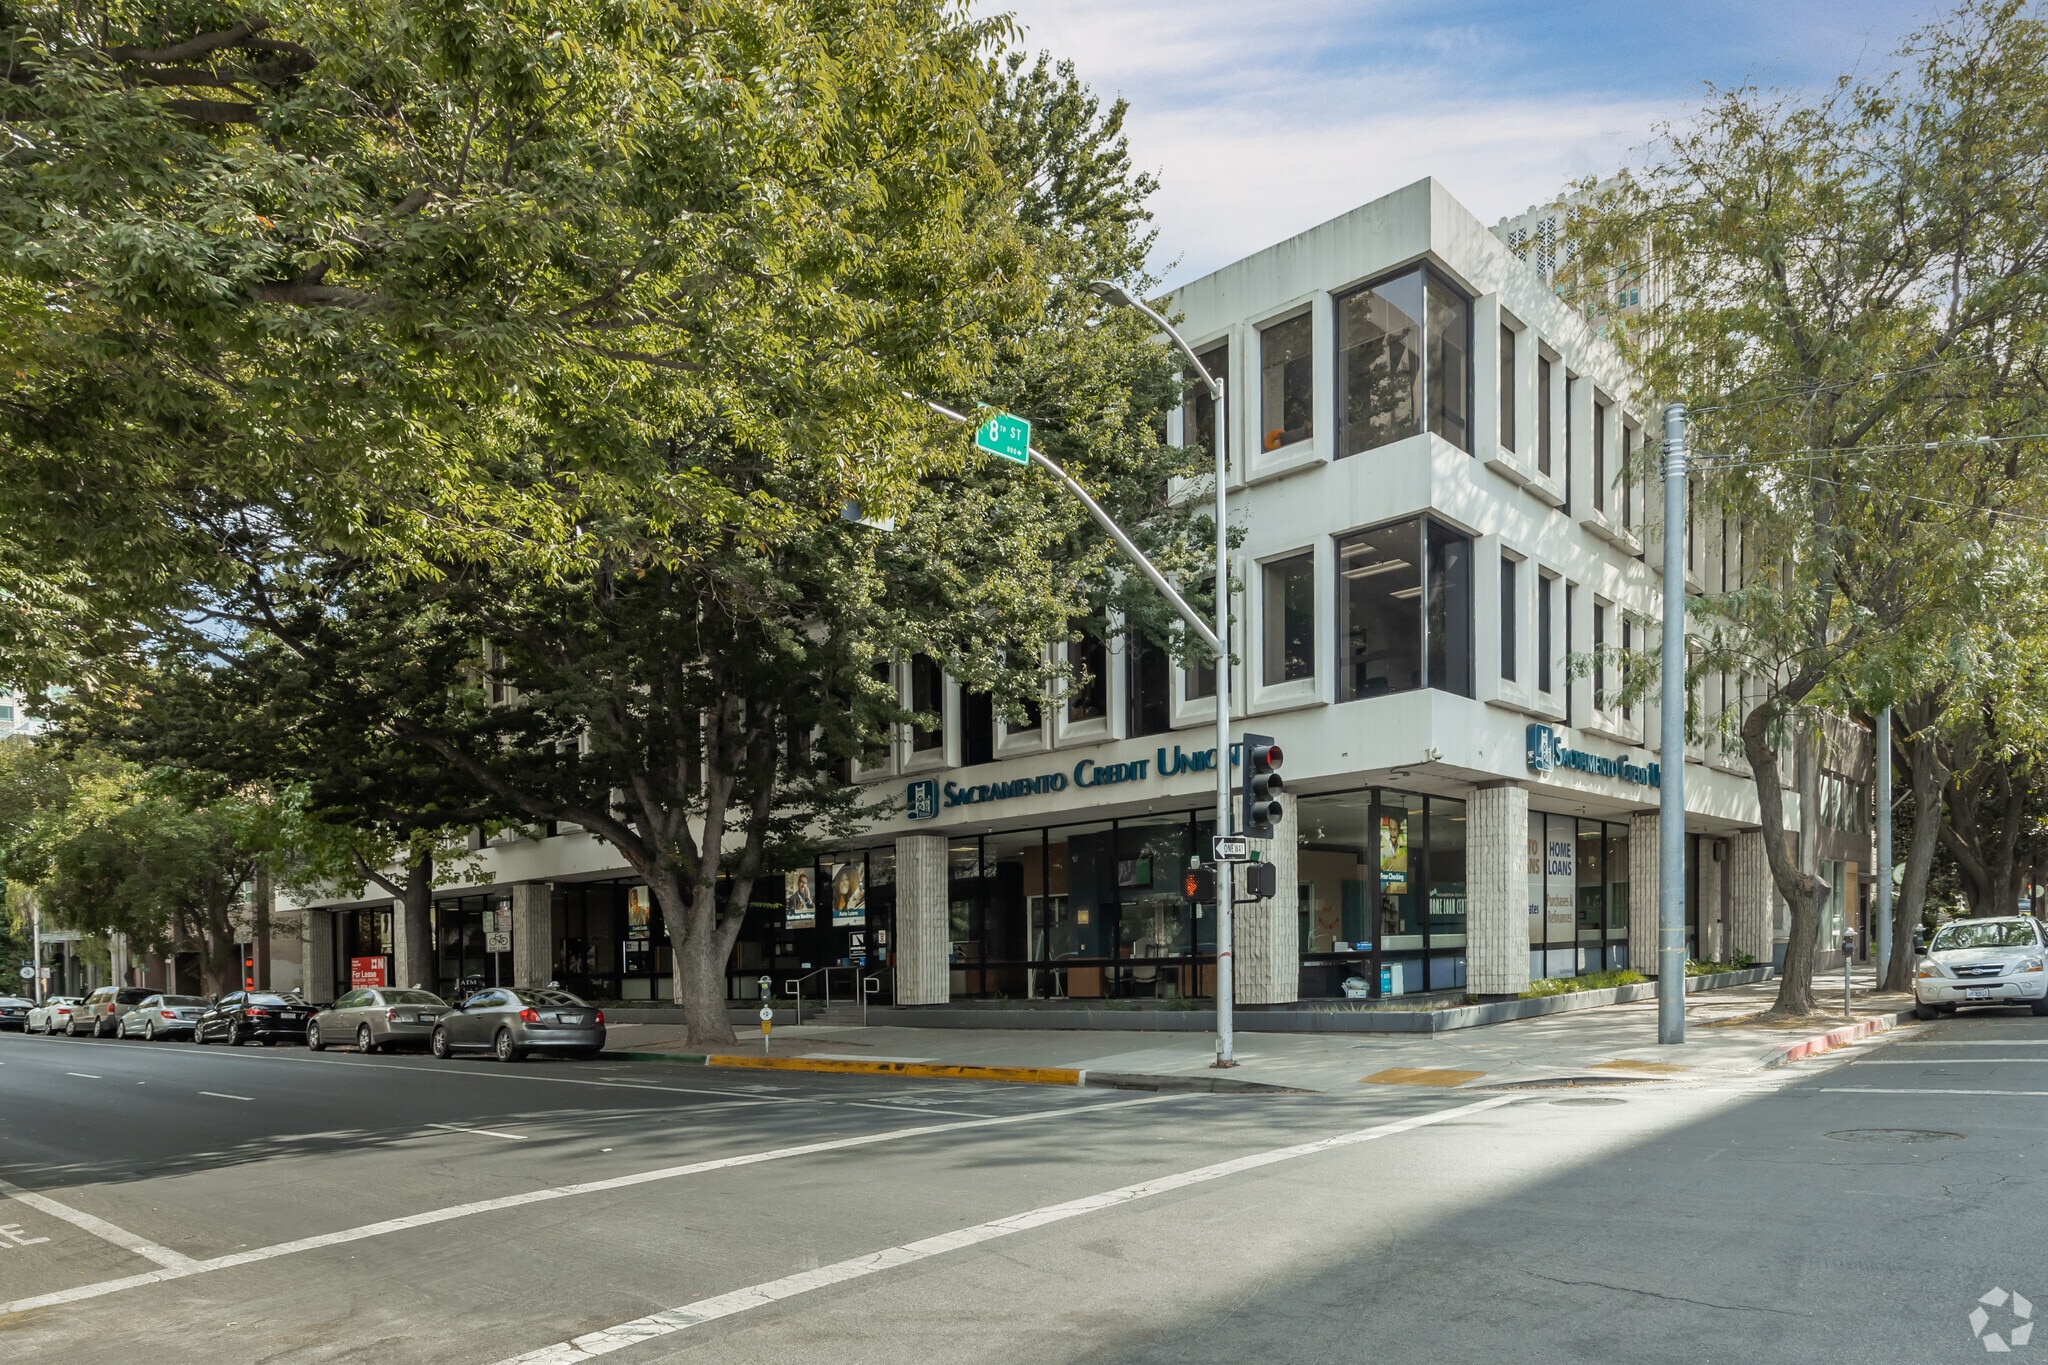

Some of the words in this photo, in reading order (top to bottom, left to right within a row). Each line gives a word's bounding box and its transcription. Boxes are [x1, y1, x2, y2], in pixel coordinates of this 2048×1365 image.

[989, 419, 1006, 442] 8TH
[1010, 427, 1021, 440] ST
[1553, 736, 1618, 778] SACRAMENTO
[944, 773, 1068, 808] SACRAMENTO
[1074, 759, 1150, 789] CREDIT
[1157, 744, 1241, 777] UNION
[1223, 844, 1234, 853] ONE
[1234, 844, 1243, 853] WAY
[1527, 838, 1538, 856] TO
[1549, 841, 1571, 858] HOME
[1548, 859, 1572, 877] LOANS
[1547, 893, 1569, 907] Purchases
[1528, 903, 1539, 915] ates
[1548, 910, 1573, 924] Refinances
